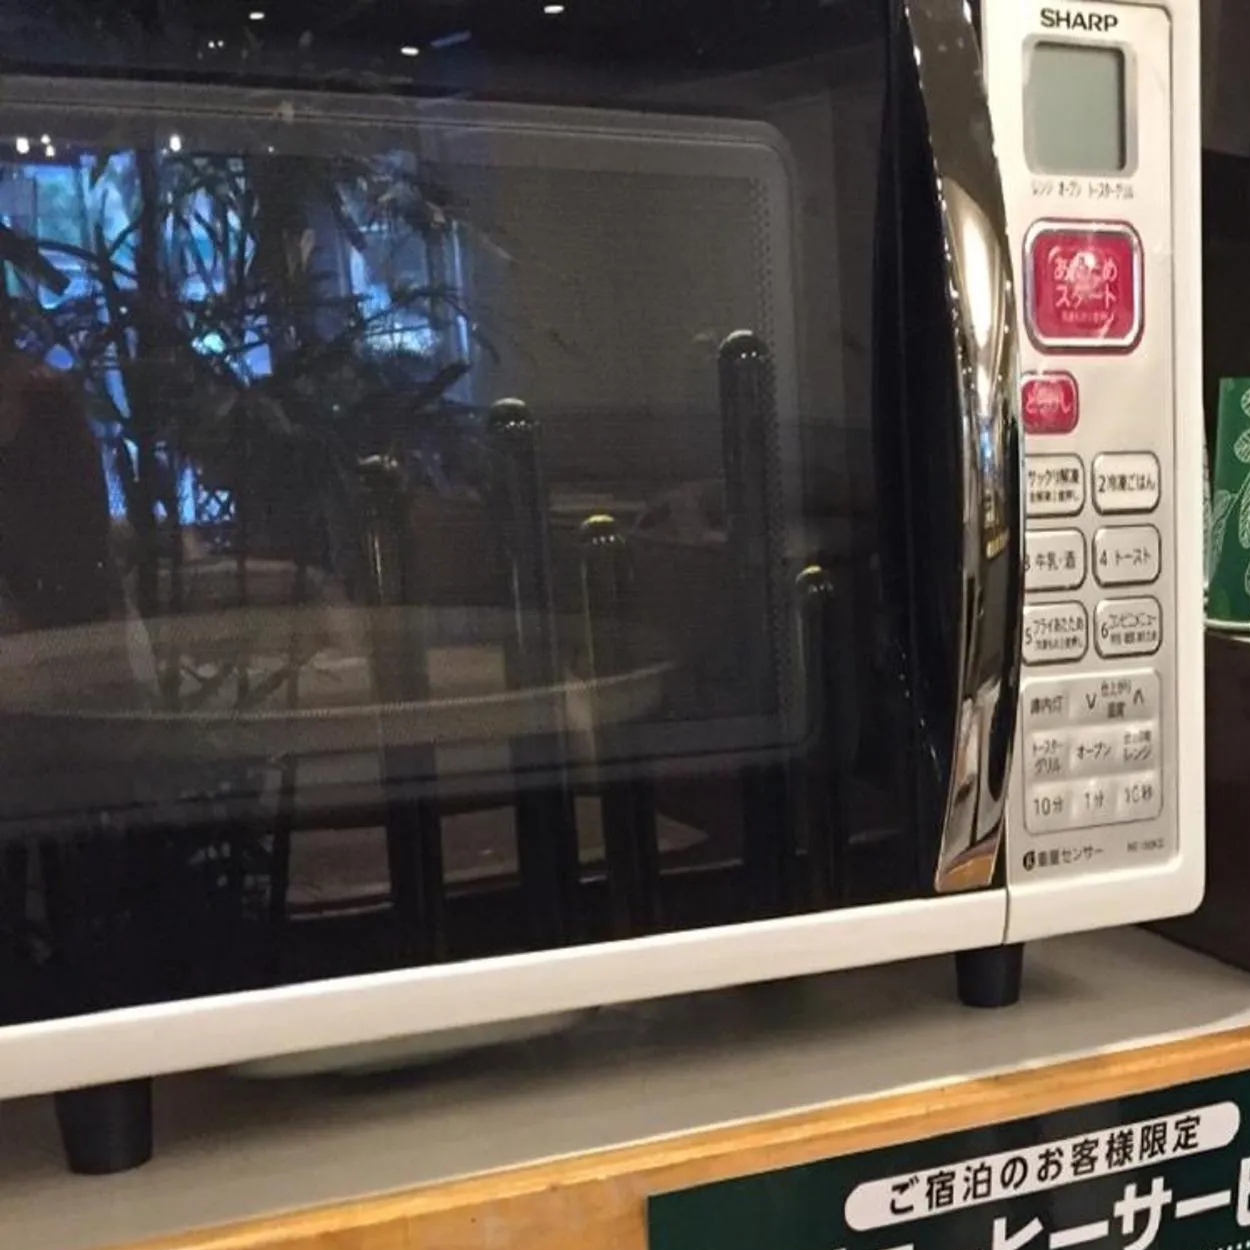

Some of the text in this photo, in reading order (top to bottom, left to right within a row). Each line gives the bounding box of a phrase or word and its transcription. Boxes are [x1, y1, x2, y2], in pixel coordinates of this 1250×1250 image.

[1040, 8, 1118, 31] SHARP
[1033, 797, 1063, 816] 10分
[889, 1115, 1201, 1216] ご宿泊のお客様限定
